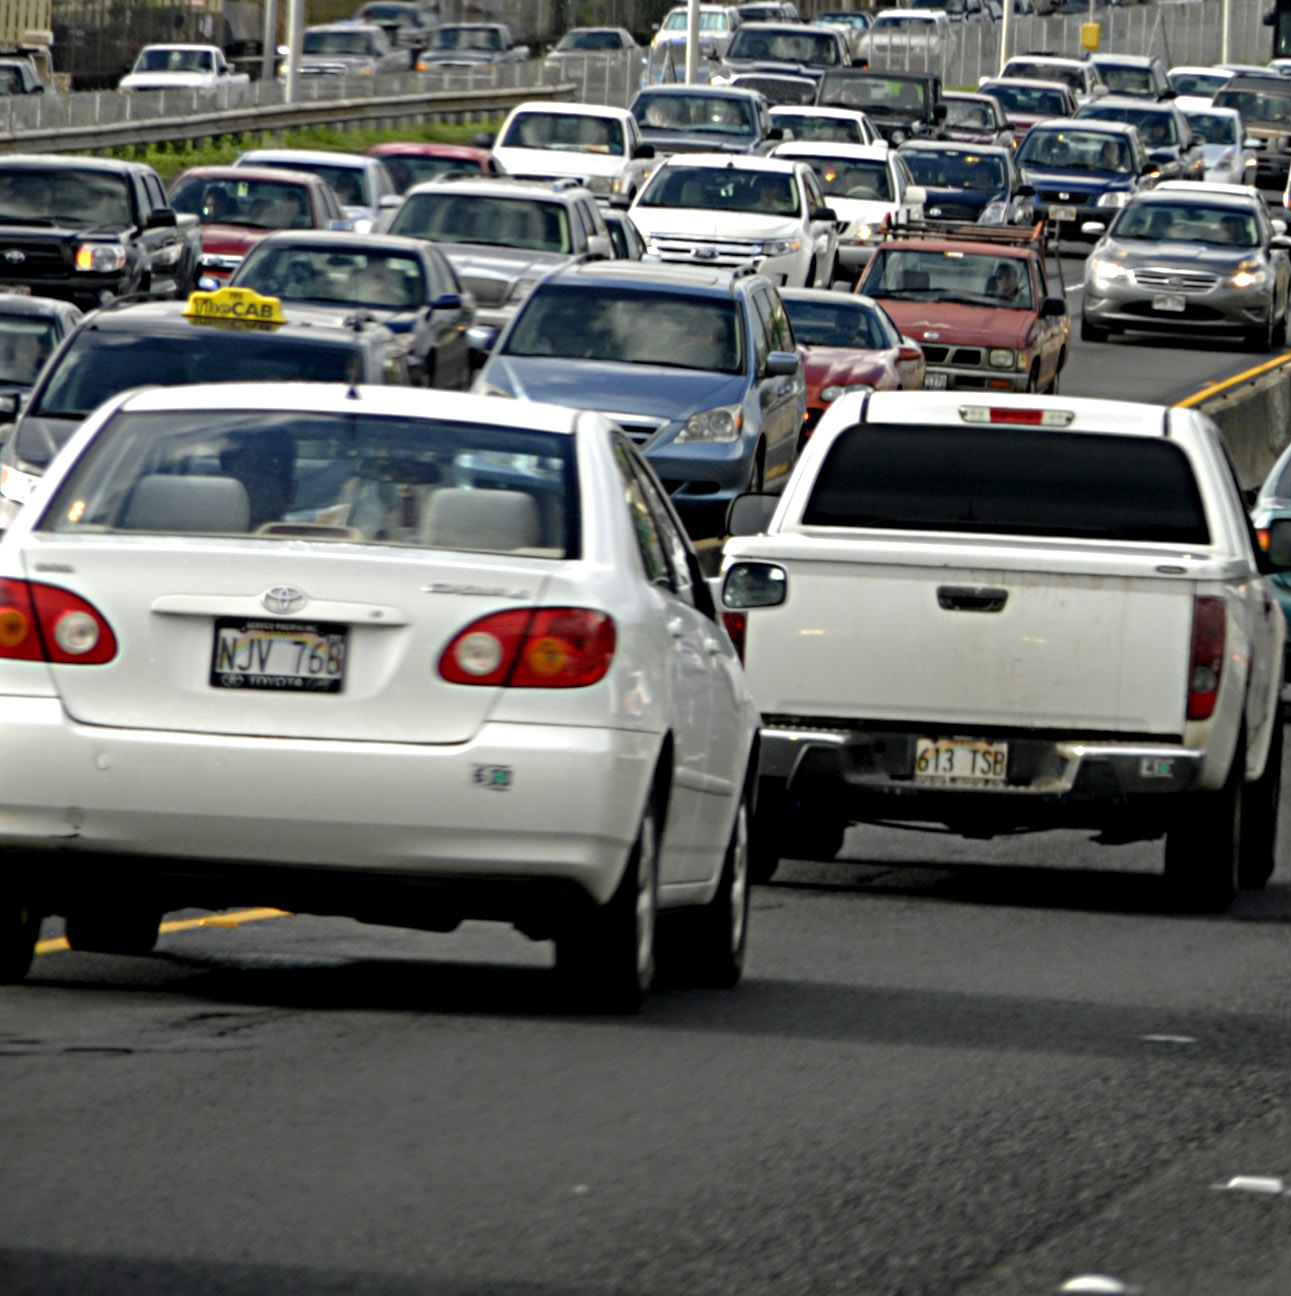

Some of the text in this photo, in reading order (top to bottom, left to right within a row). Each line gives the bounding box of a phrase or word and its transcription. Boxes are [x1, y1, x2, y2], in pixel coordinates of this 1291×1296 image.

[219, 635, 273, 673] NJV
[916, 747, 1005, 777] 613 TSB
